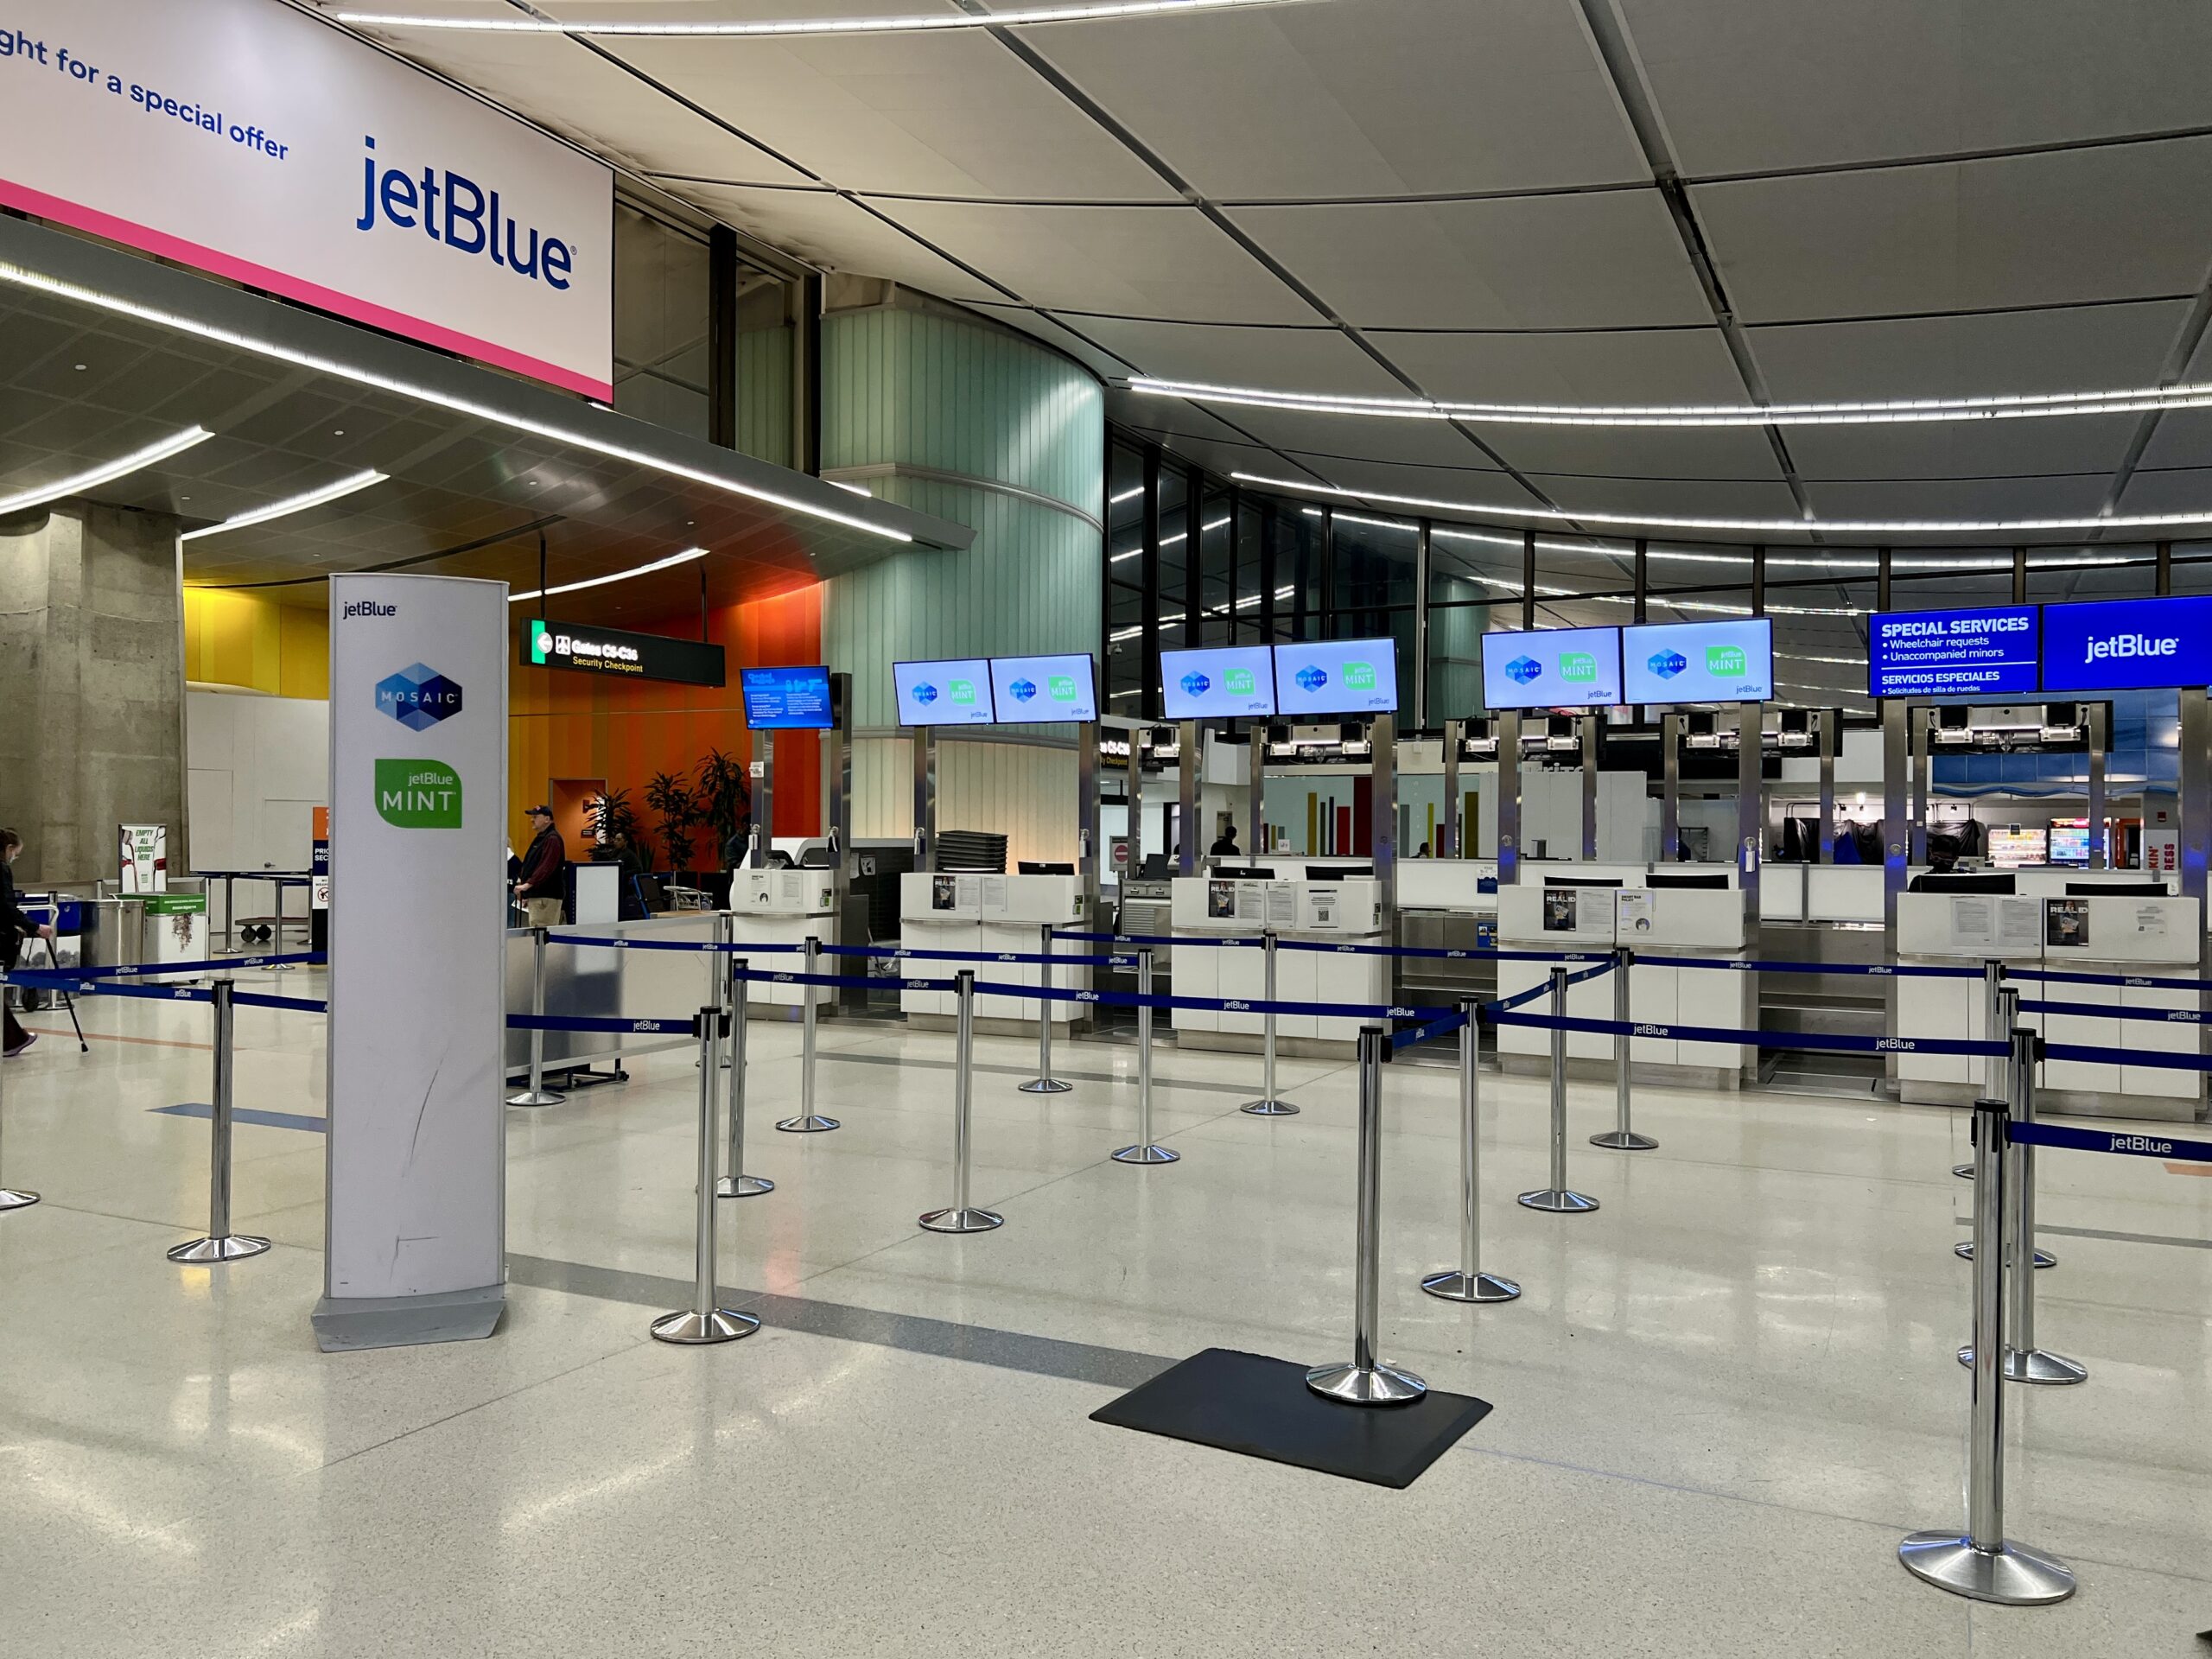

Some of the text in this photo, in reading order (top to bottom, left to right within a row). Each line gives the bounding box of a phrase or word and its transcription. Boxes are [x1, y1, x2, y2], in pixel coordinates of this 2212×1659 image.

[56, 48, 99, 84] for
[106, 74, 122, 94] a
[130, 83, 221, 135] special
[229, 124, 289, 160] offer
[357, 136, 573, 291] jetBlue
[343, 601, 395, 620] jetBlue
[1882, 617, 2029, 637] SPECIAL SERVICES
[1890, 637, 1989, 649] Wheelchair requests
[2085, 633, 2177, 664] jetBlue
[1891, 649, 2005, 661] Unaccompanied minors
[572, 657, 644, 673] Security Checkpoint
[1563, 665, 1593, 676] MINT
[1710, 659, 1743, 671] MINT
[1345, 674, 1373, 684] MINT
[1882, 671, 2000, 684] SERVICIOS ESPECIALES
[1227, 680, 1252, 690] MINT
[1736, 685, 1763, 695] jetBlue
[1051, 687, 1074, 696] MINT
[1587, 690, 1612, 699] jetBlue
[381, 692, 455, 703] MOSAIC
[408, 772, 454, 785] jetBlue
[383, 791, 454, 811] MINT
[116, 966, 138, 975] jetBlue
[1729, 961, 1752, 969] jetBlue
[1868, 965, 1892, 974] jetBlue
[773, 973, 794, 982] jetBlue
[907, 980, 929, 988] jetBlue
[1076, 991, 1099, 1001] jetBlue
[1224, 1000, 1249, 1010] jetBlue
[1387, 1007, 1414, 1018] jetBlue
[2167, 1010, 2201, 1021] jetBlue
[633, 1019, 660, 1032] jetBlue
[1633, 1023, 1669, 1036] jetBlue
[1875, 1038, 1916, 1051] jetBlue
[2110, 1134, 2172, 1154] jetBlue
